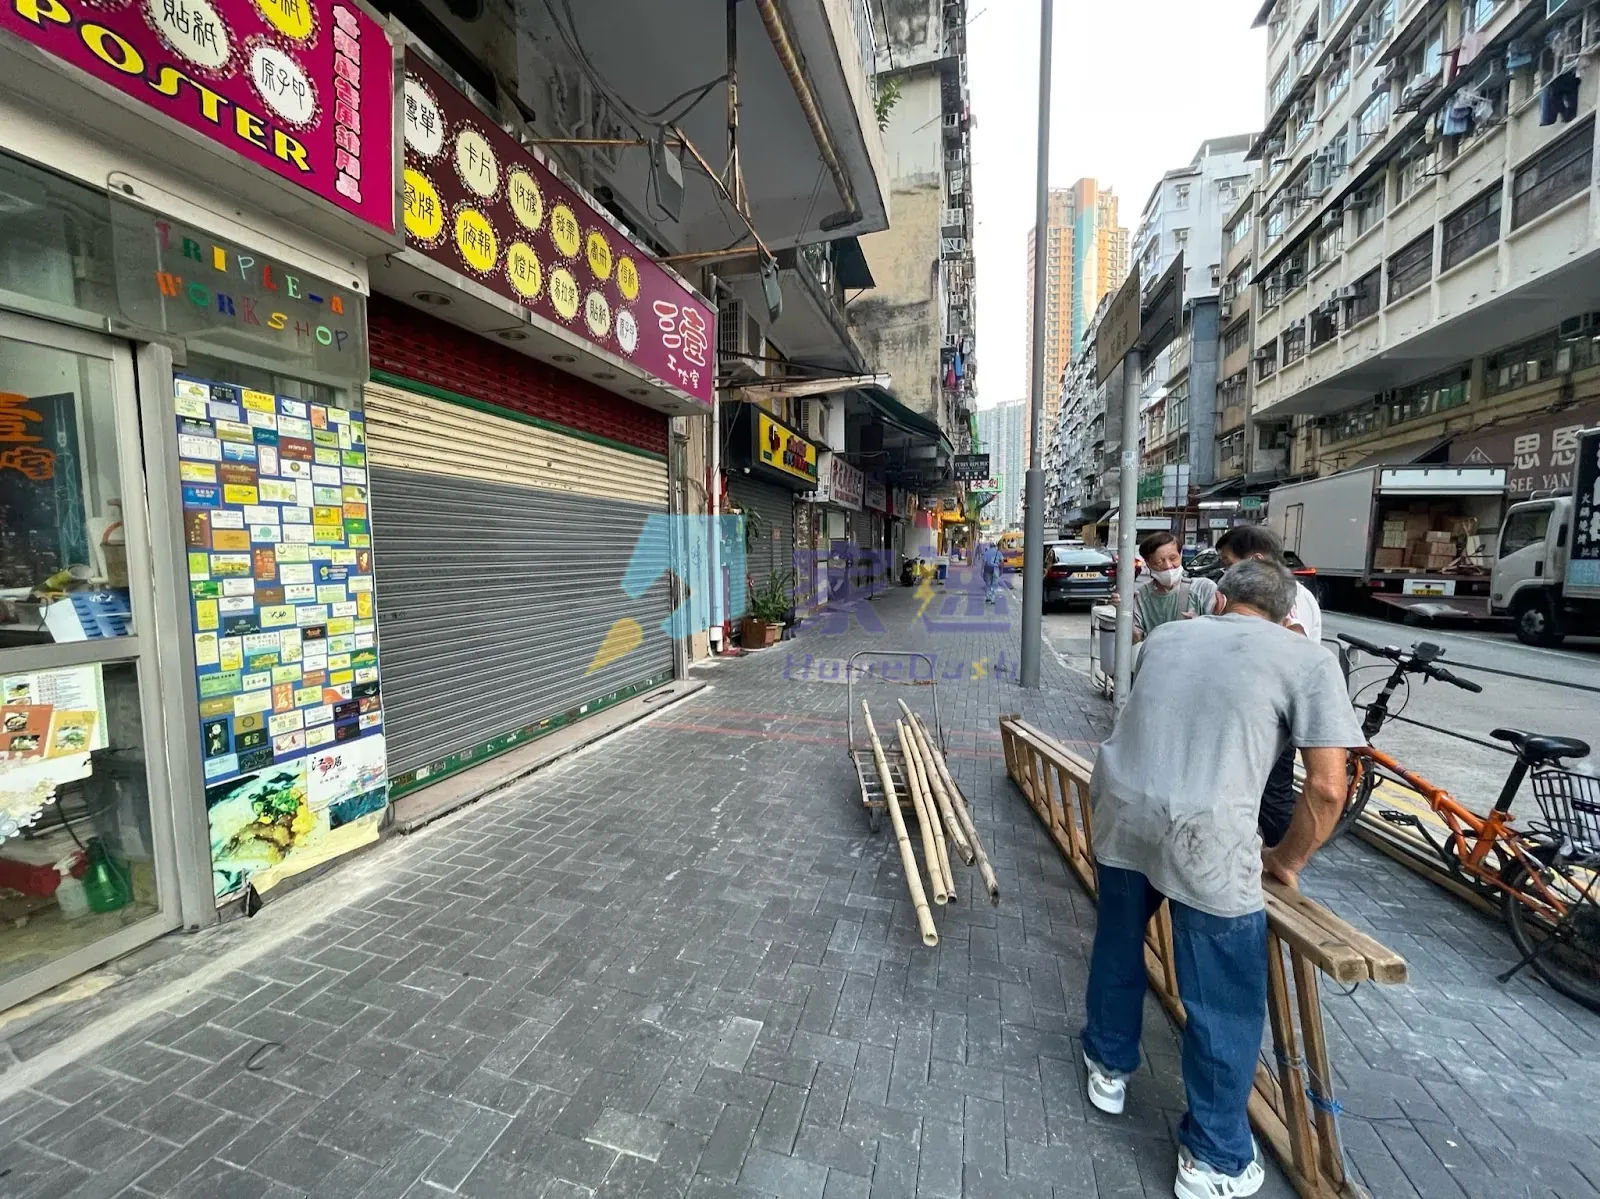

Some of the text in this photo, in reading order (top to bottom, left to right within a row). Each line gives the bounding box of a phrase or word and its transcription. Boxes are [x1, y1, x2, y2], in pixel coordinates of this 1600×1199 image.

[159, 0, 219, 56] 貼紙
[15, 0, 311, 172] POSTER
[261, 57, 306, 111] 原子印
[464, 142, 491, 184] 卡片
[462, 219, 492, 261] 海報
[555, 211, 576, 246] 發票
[155, 270, 349, 353] WORKSHOP
[1514, 424, 1585, 470] 思恩
[1509, 472, 1571, 493] SEE YAN
